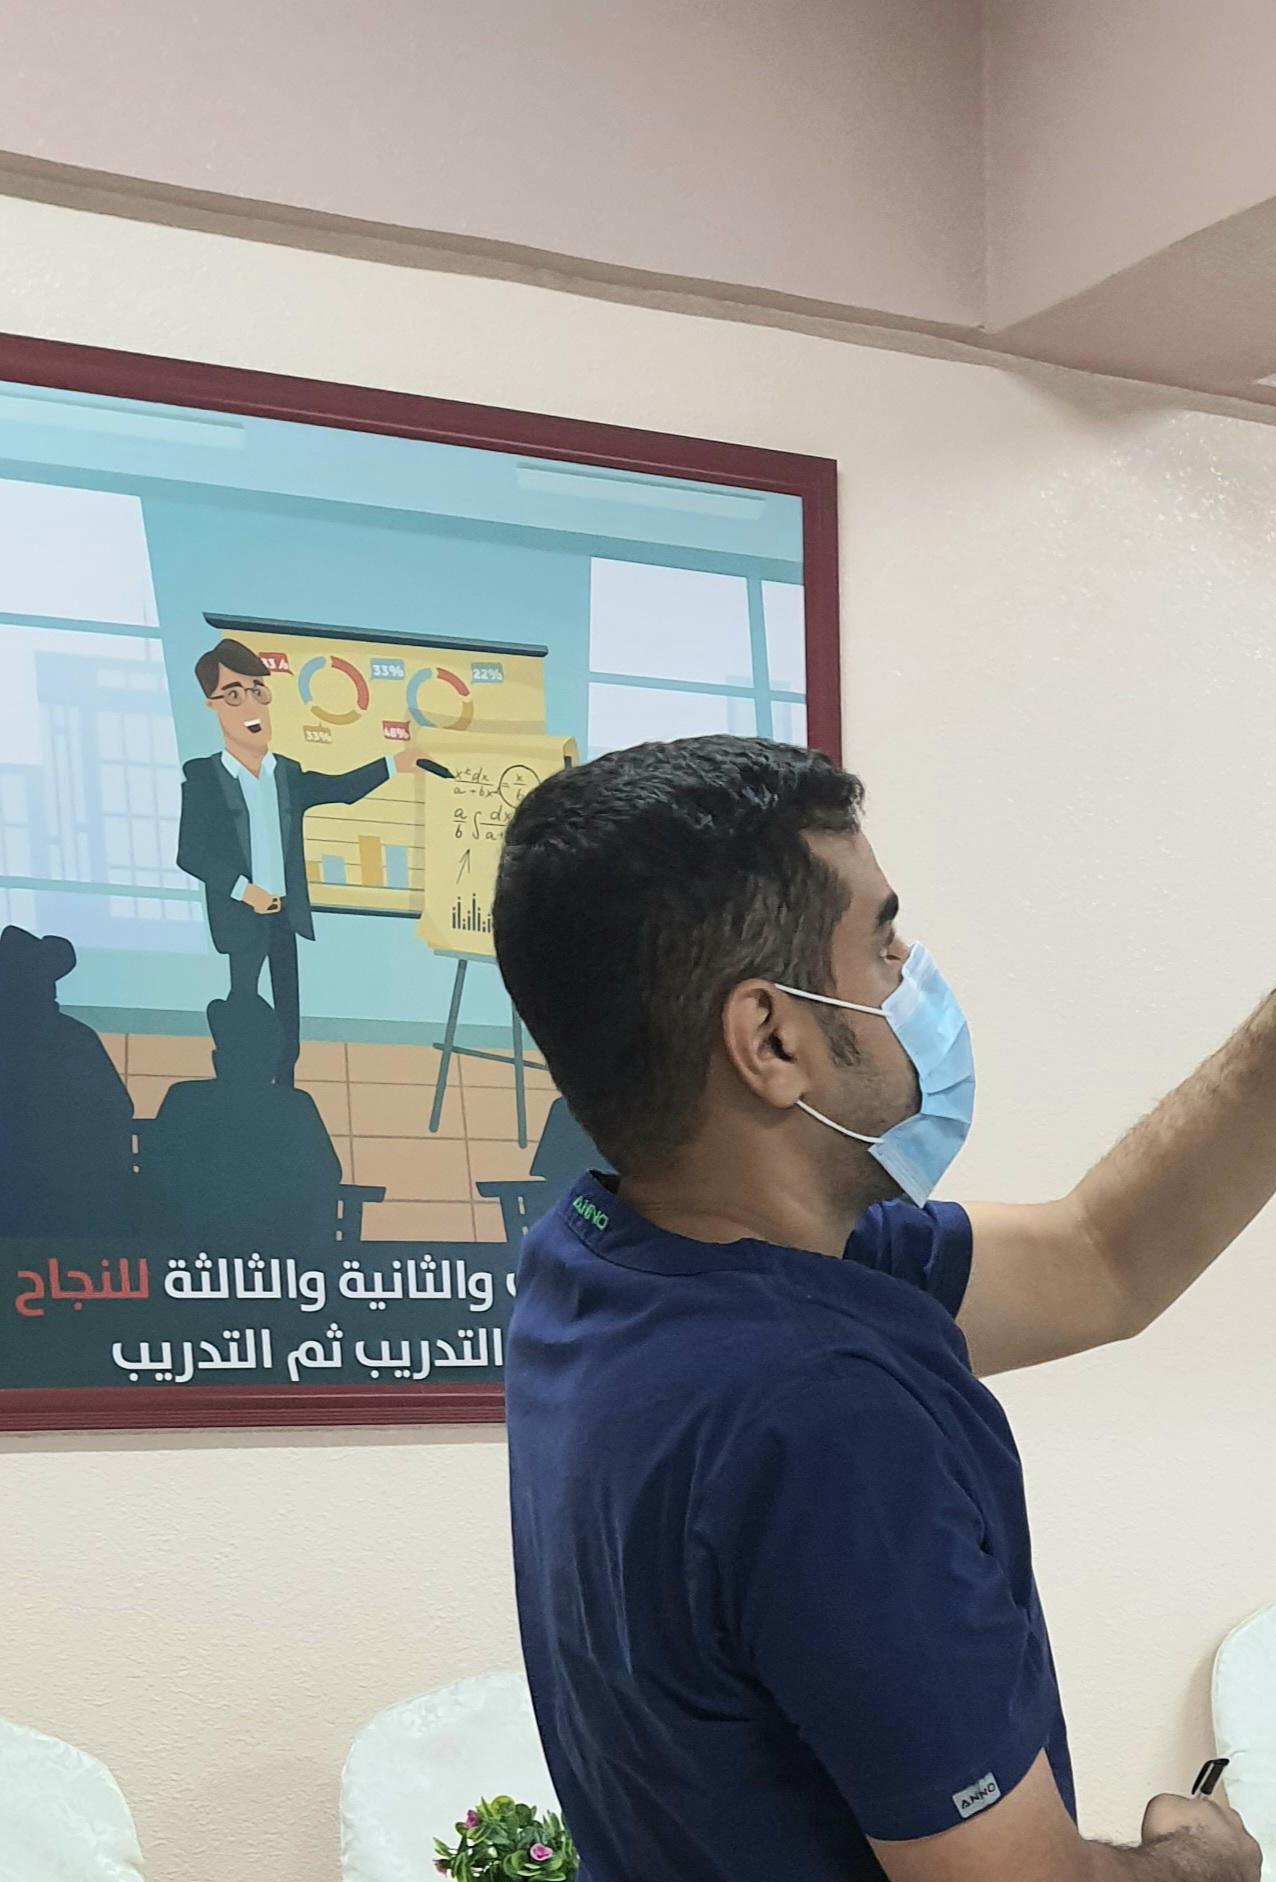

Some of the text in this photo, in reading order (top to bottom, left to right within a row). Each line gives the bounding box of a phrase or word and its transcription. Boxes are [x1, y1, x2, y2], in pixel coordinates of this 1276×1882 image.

[372, 664, 404, 678] 33%
[473, 668, 503, 681] 22%
[304, 730, 332, 743] 33%
[15, 1257, 150, 1317] للنجاح
[164, 1252, 326, 1312] والثالثة
[339, 1253, 494, 1312] والثانية
[112, 1322, 504, 1383] التدريب ثم التدريب
[961, 1782, 997, 1810] ANNO
